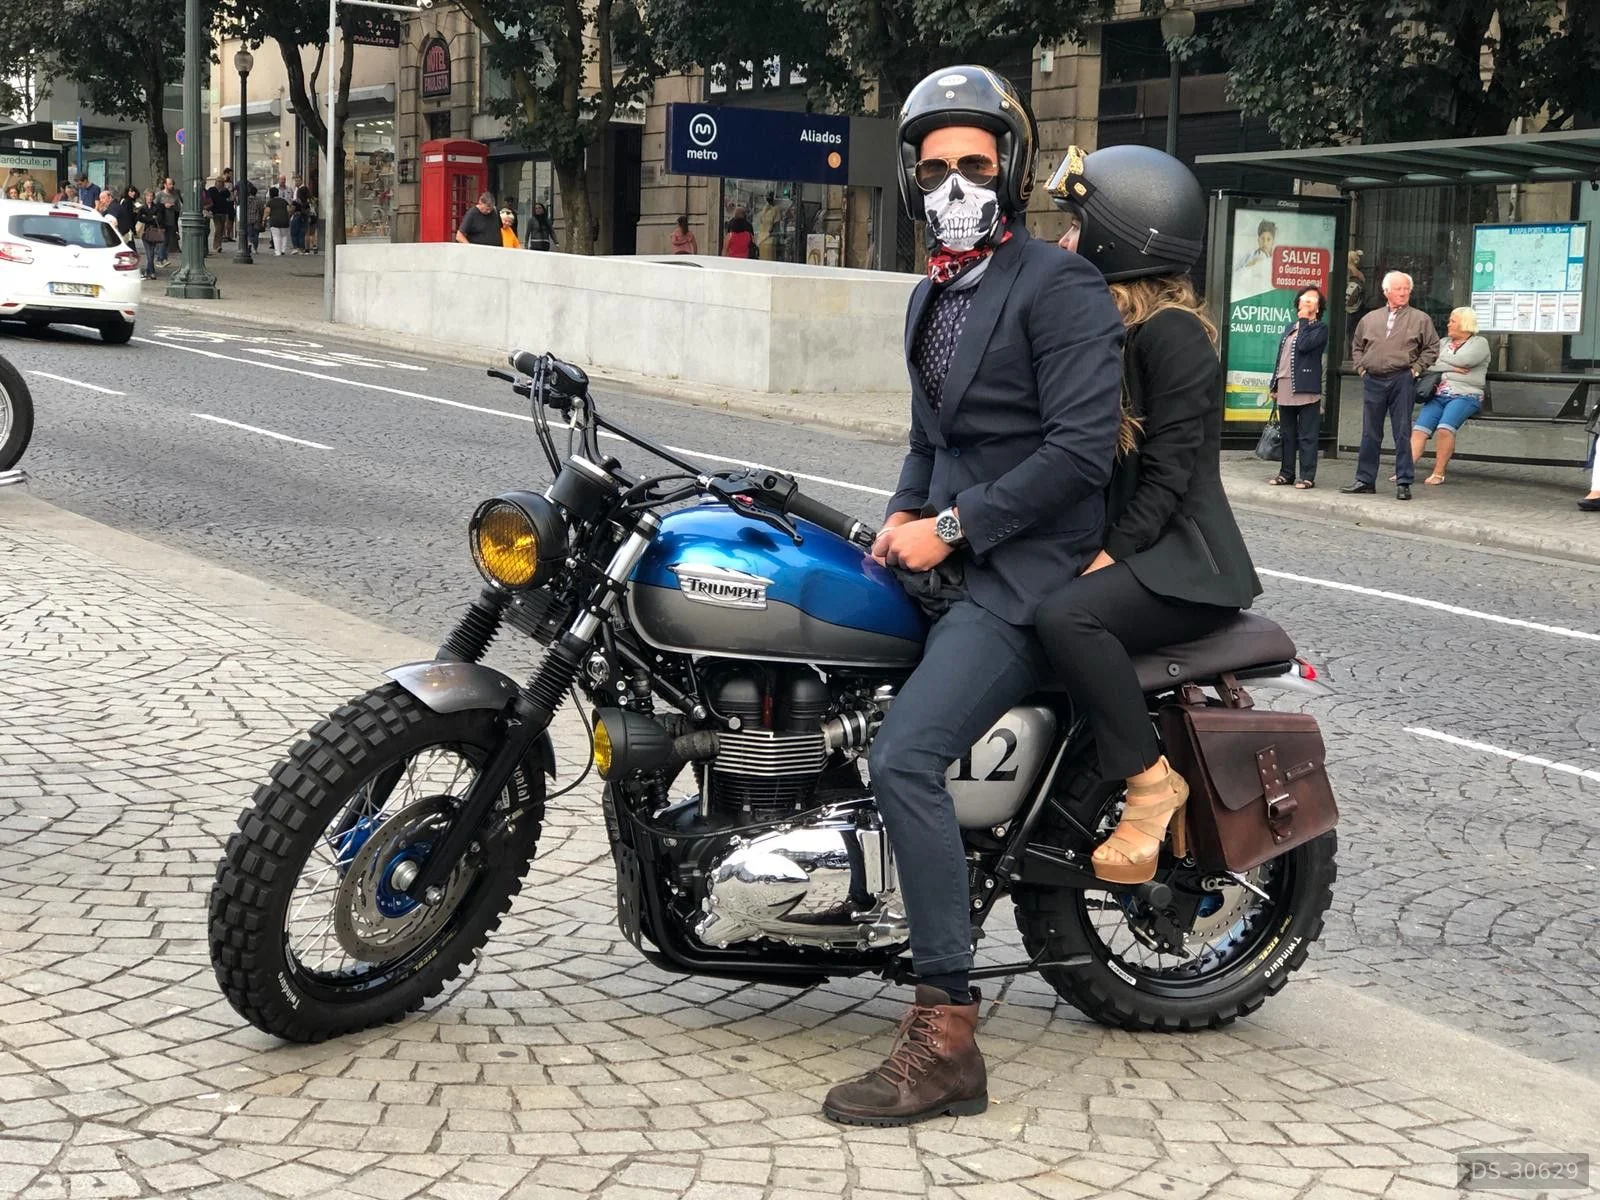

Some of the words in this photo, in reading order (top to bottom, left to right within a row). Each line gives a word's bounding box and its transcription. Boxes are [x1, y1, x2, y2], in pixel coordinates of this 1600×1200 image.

[800, 129, 842, 144] Aliados
[687, 149, 718, 160] metro
[1282, 250, 1320, 265] SALVEI
[1284, 264, 1310, 276] Gustavo
[1231, 305, 1292, 323] ASPIRINA
[1230, 323, 1254, 333] SALVA
[1255, 324, 1261, 333] O
[1263, 324, 1276, 333] TEU
[687, 578, 760, 599] TRIUMPH
[1264, 936, 1302, 978] Twinduro
[277, 971, 300, 1010] Twinduro
